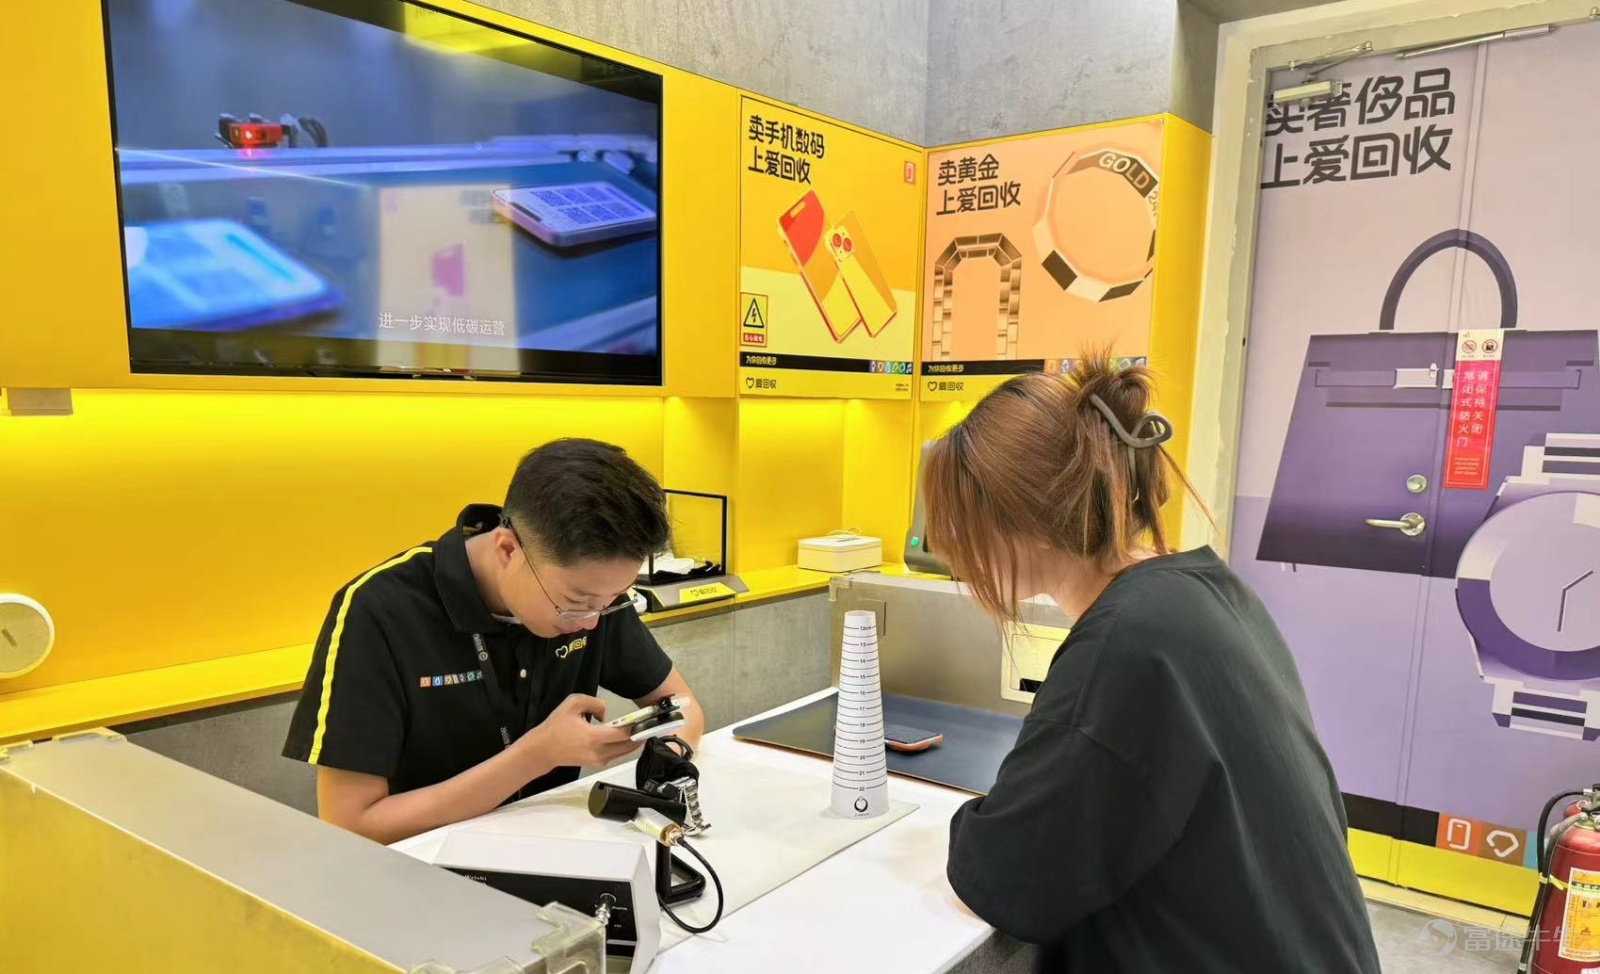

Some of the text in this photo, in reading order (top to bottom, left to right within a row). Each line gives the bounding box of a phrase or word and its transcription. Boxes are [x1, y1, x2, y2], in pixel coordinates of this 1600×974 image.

[748, 114, 825, 159] 卖手机数码
[1260, 123, 1454, 190] 上爱回收
[748, 145, 811, 185] 上爱回收
[938, 152, 1000, 187] 卖黄金
[1098, 150, 1150, 190] GOLD
[936, 180, 1022, 216] 上爱回收
[378, 311, 506, 337] 进一步实现低碳运营
[1456, 370, 1475, 448] 常闭式防火门
[1471, 370, 1489, 434] 请保持关闭
